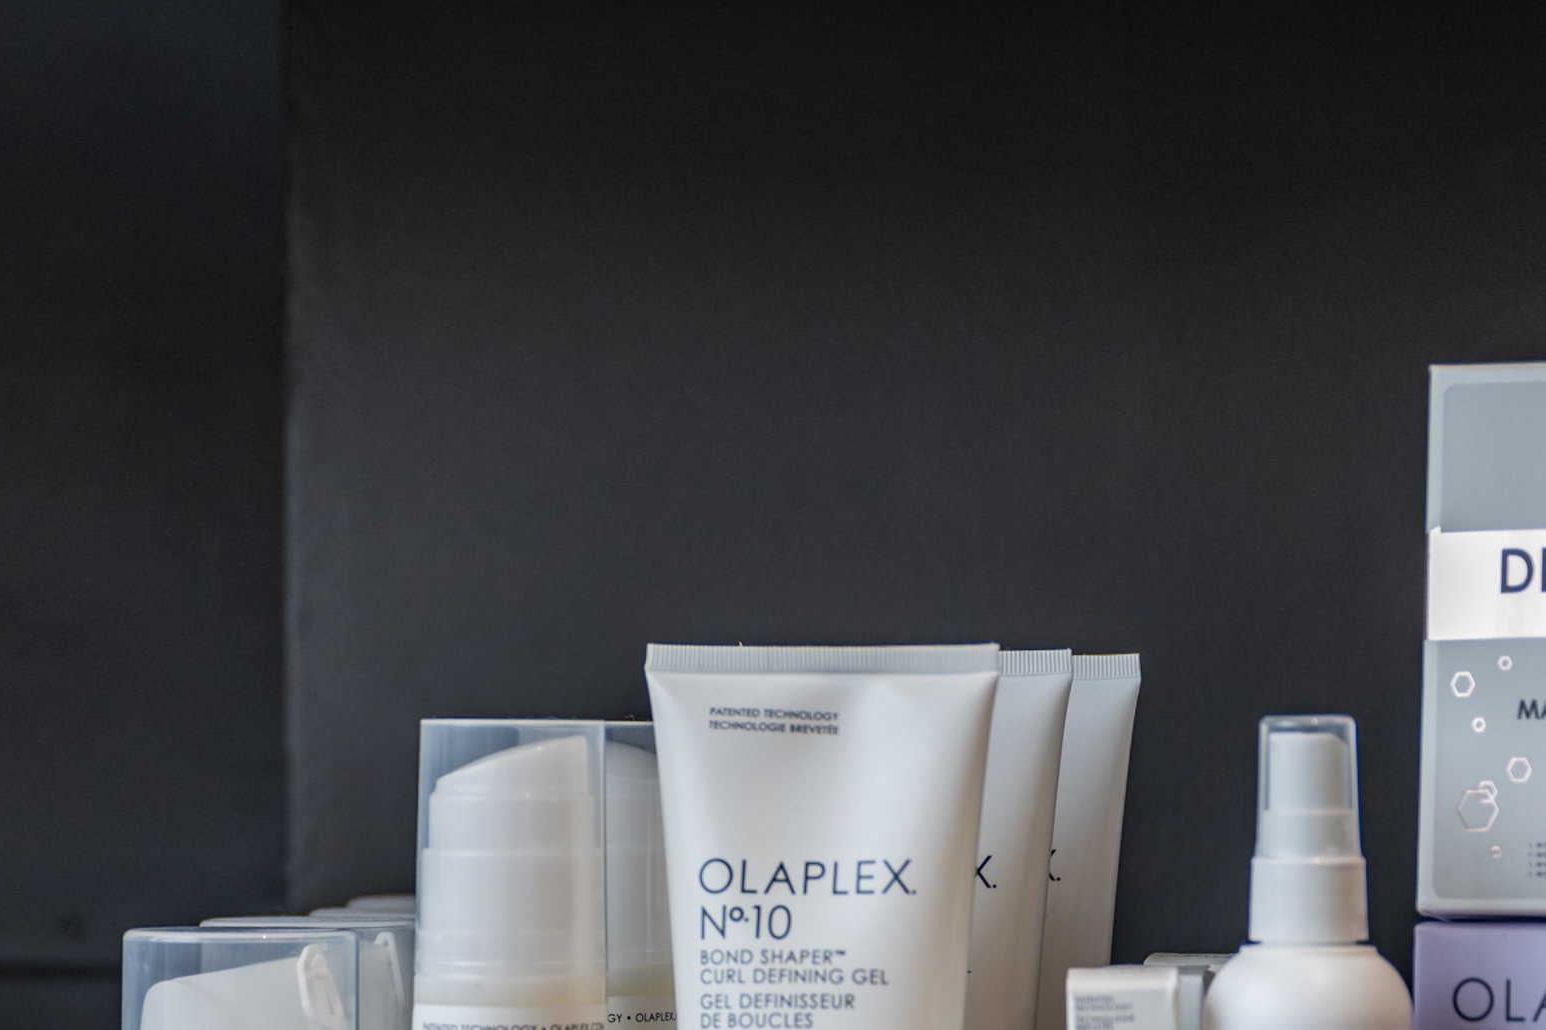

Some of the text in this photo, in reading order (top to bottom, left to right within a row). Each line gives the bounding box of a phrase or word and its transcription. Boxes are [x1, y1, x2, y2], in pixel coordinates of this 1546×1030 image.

[709, 707, 760, 718] PATENTED
[700, 949, 754, 966] BOND
[700, 968, 888, 986] CURL DEFINING GEL
[700, 1012, 813, 1029] DE BOUCLES
